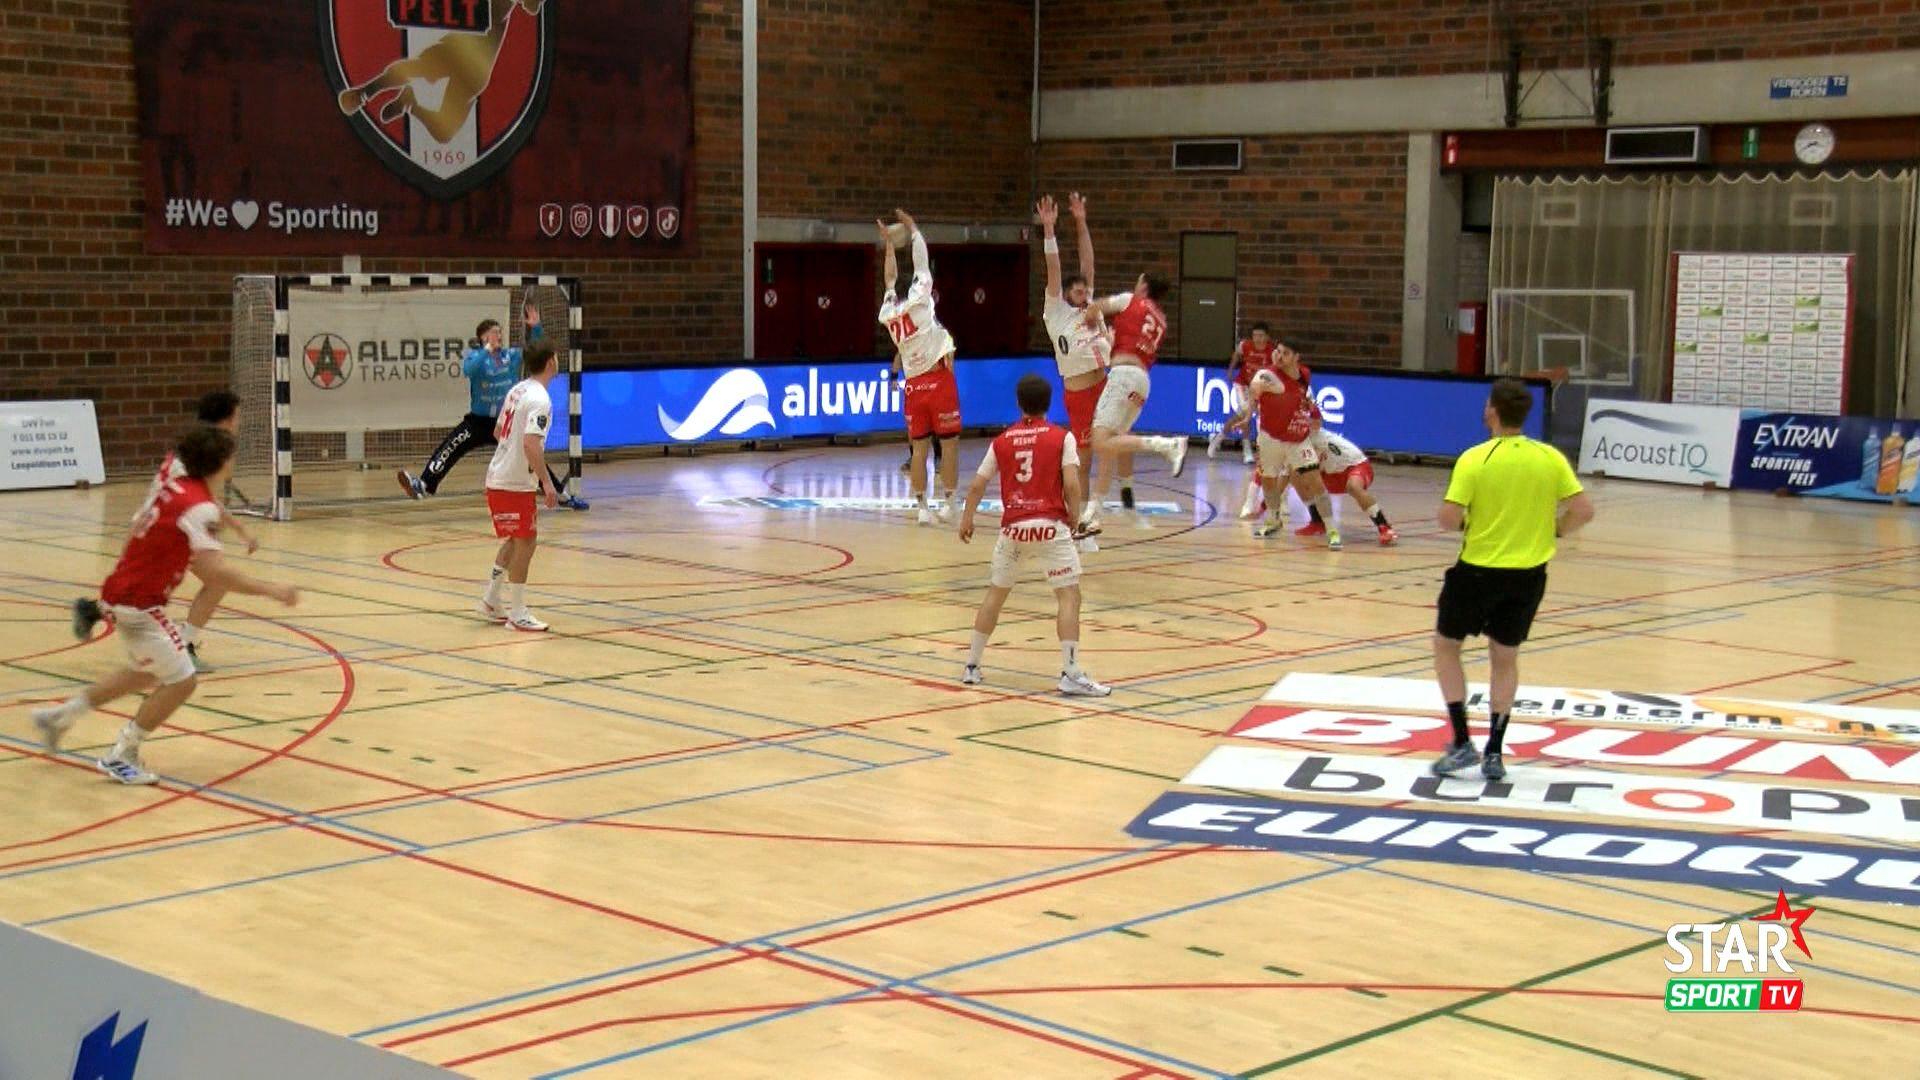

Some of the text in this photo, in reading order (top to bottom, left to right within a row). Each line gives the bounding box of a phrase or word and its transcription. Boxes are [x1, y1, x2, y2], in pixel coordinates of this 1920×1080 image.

[399, 0, 479, 27] PELT
[422, 150, 466, 165] 1969
[165, 198, 379, 236] #We Sporting
[1753, 419, 1840, 449] EXTRAN
[1015, 450, 1033, 482] 3
[1751, 456, 1812, 473] SPORTING
[1788, 472, 1818, 486] PELT
[1283, 756, 1920, 822] burop
